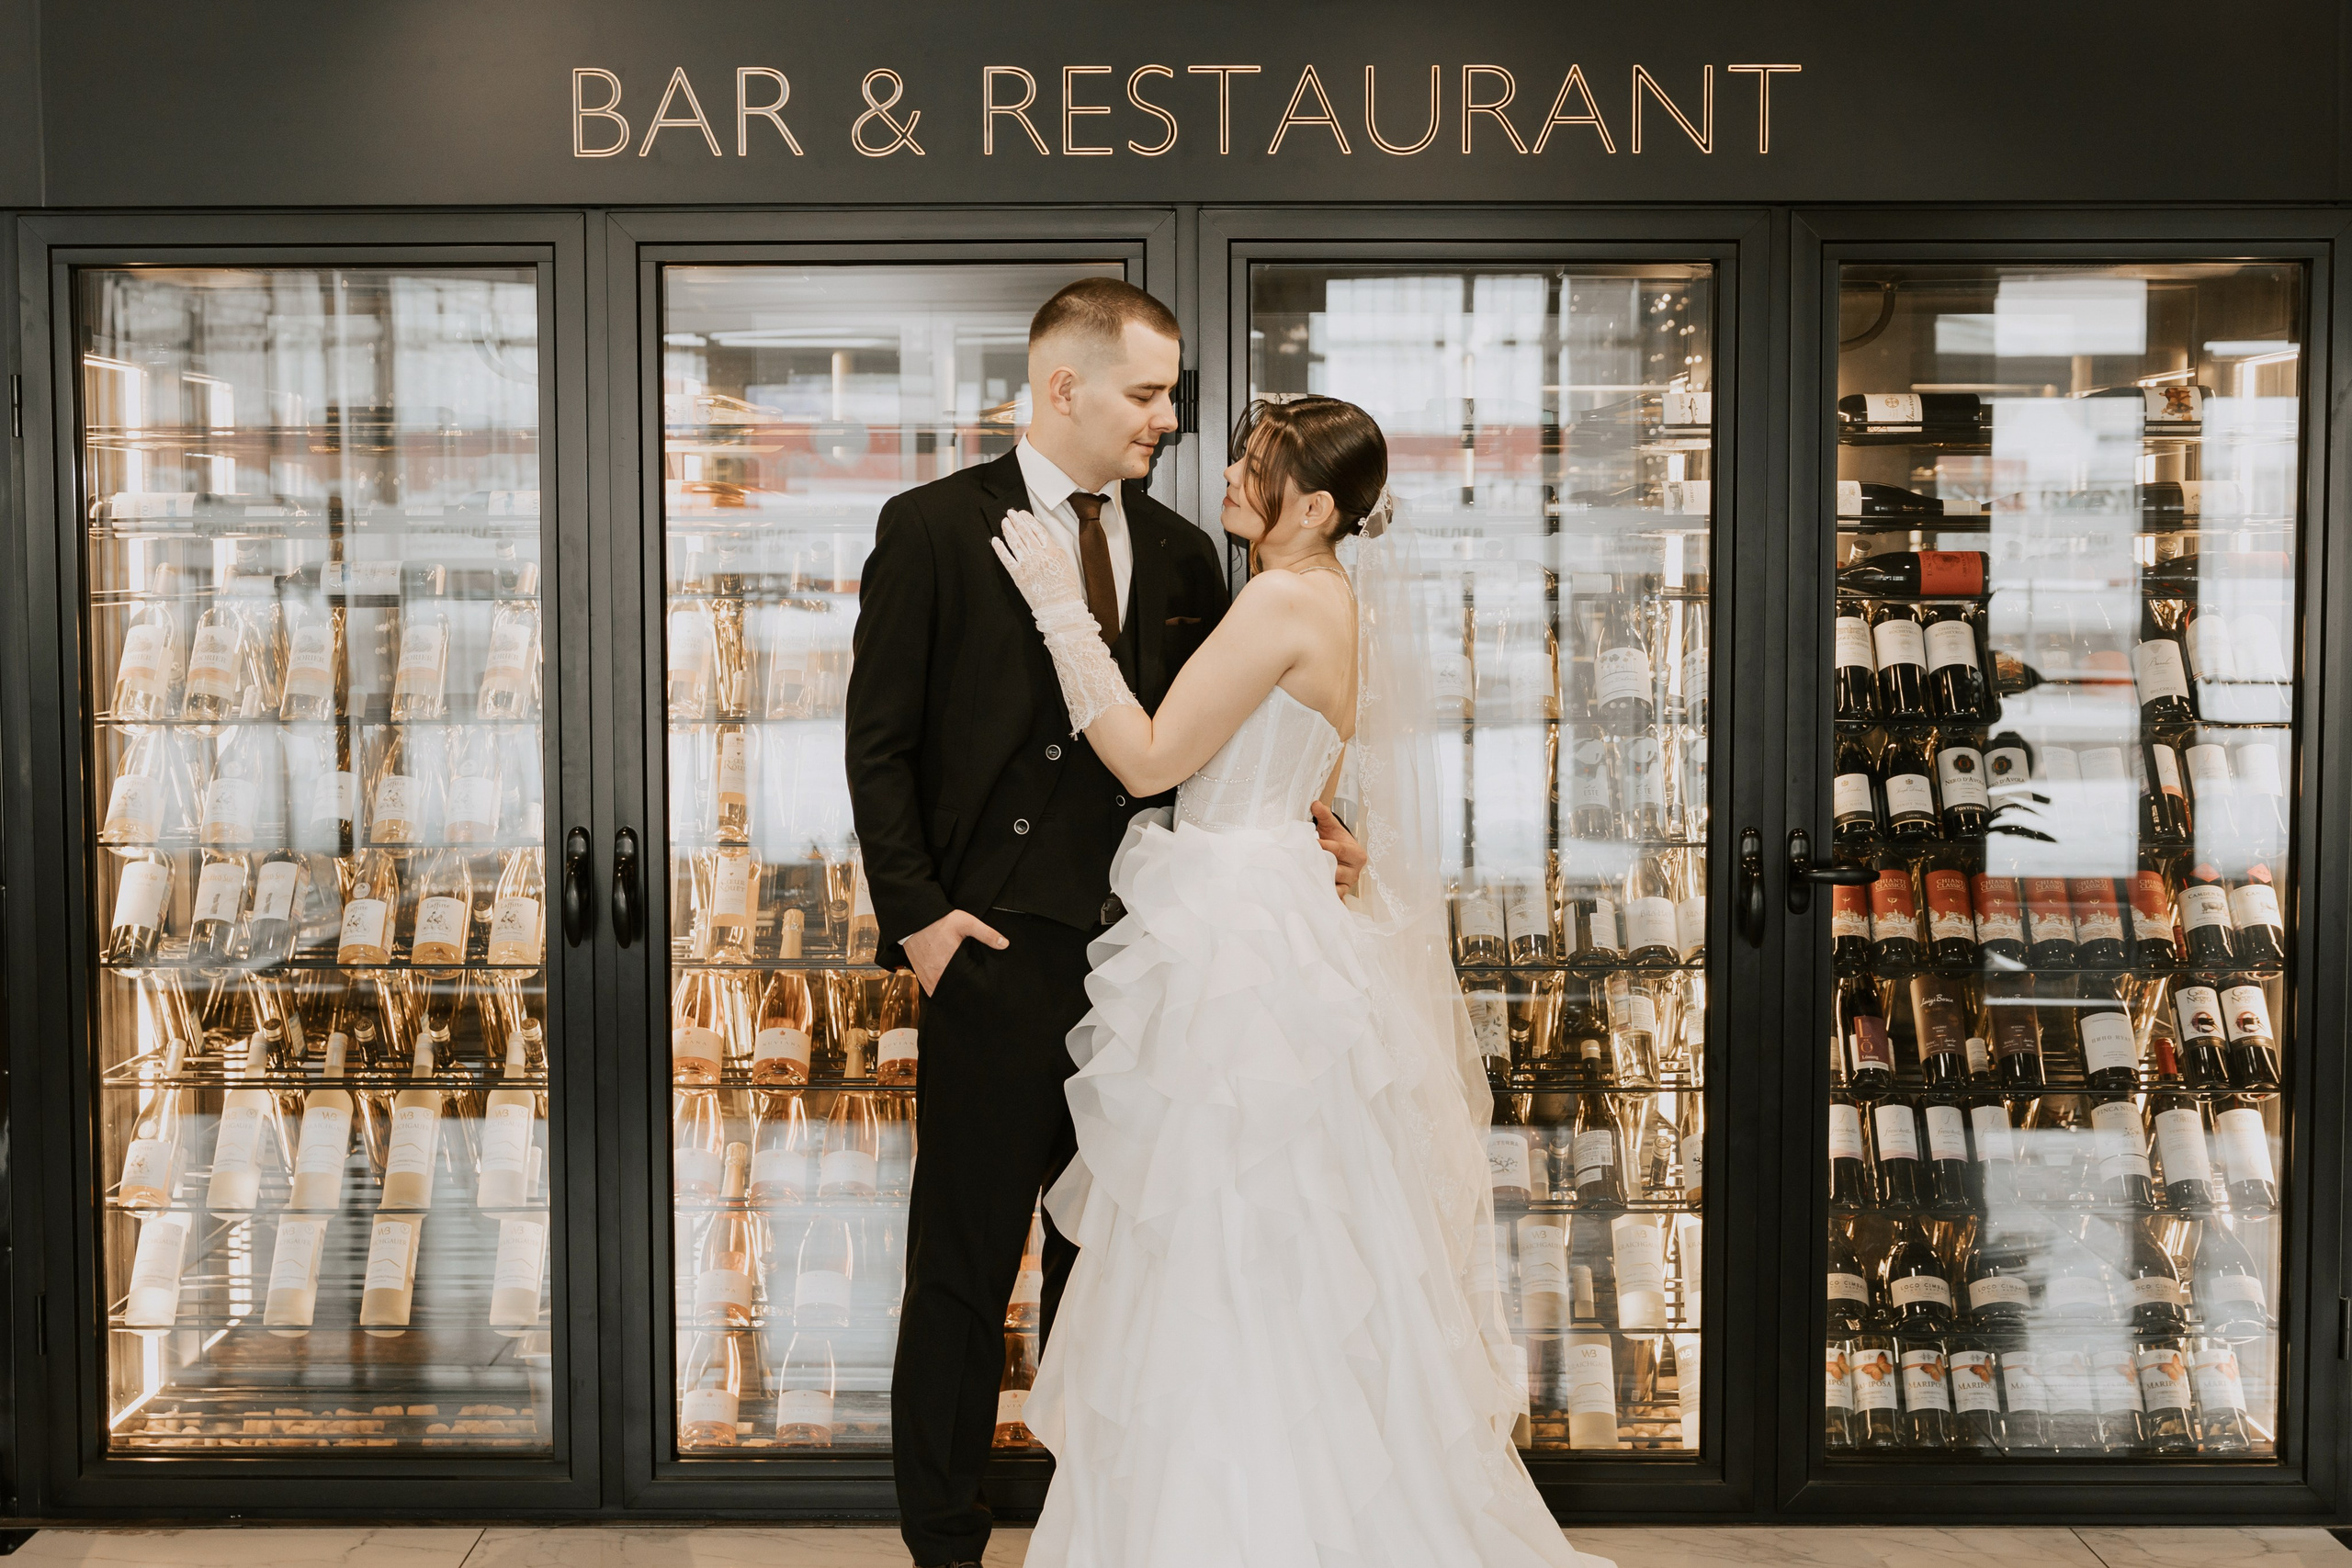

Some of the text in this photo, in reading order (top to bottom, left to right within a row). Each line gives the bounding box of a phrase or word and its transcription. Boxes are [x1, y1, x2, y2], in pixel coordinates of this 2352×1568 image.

[571, 63, 1803, 158] BAR & RESTAURANT
[1945, 776, 1985, 786] NERO D'AVOLA
[2076, 879, 2108, 887] CHIANTI
[2188, 890, 2215, 898] CAMDEN
[426, 902, 450, 914] Laffitte
[501, 902, 524, 913] Laffitte
[2188, 987, 2210, 998] Gato
[2233, 987, 2255, 998] Gato
[1920, 996, 1936, 1008] Luigi
[2187, 995, 2212, 1005] Negro
[2232, 995, 2257, 1005] Negro
[763, 1040, 801, 1048] NUVIANA
[884, 1041, 914, 1049] NUVIAN
[2097, 1105, 2119, 1116] FINCA
[1617, 1241, 1660, 1251] KRAICHGAU
[1901, 1282, 1919, 1291] LOCO
[1977, 1283, 1996, 1292] LOCO
[1826, 1379, 1849, 1388] IPOSA
[1907, 1380, 1947, 1390] MARIPOSA
